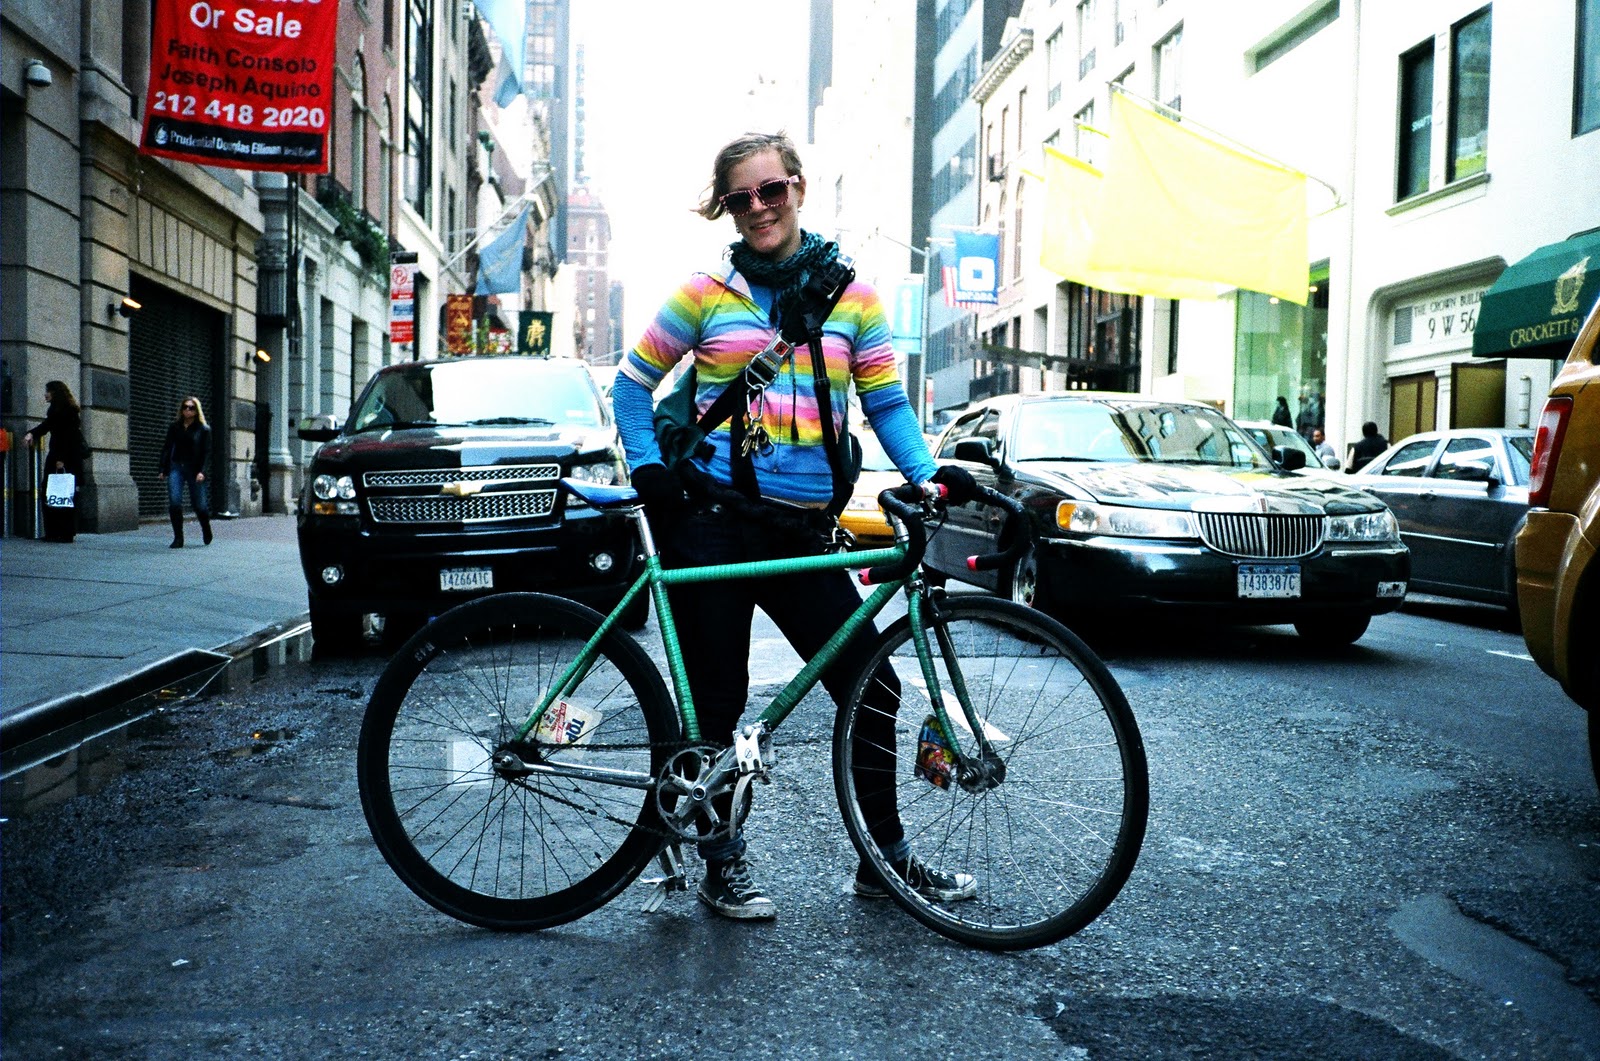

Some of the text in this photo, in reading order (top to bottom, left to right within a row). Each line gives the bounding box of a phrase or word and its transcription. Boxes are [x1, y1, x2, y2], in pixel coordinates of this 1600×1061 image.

[189, 2, 302, 38] Or Sale
[168, 39, 220, 66] Faith
[160, 63, 321, 101] Joseph Aquino
[153, 91, 325, 128] 212 418 2020
[1428, 308, 1476, 339] 9 W 56
[1510, 319, 1570, 348] CROCKETT
[1242, 574, 1296, 591] T438387C
